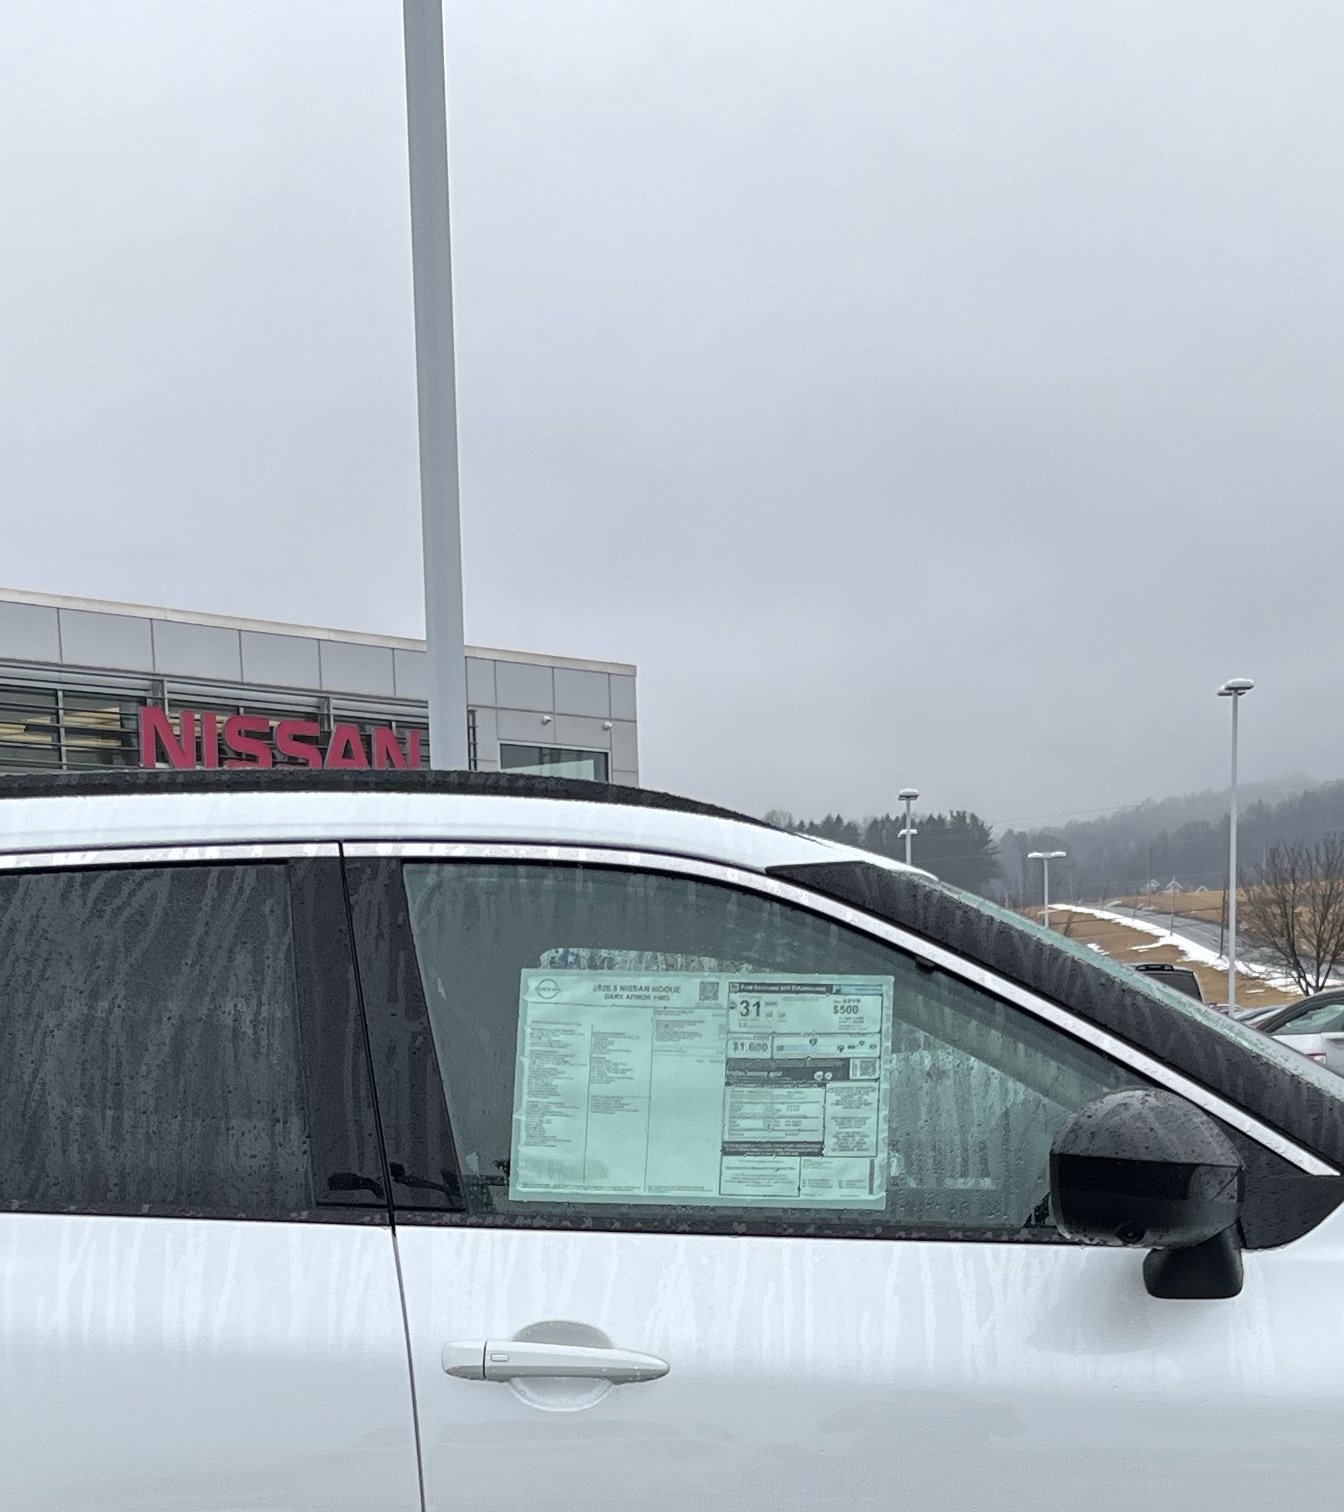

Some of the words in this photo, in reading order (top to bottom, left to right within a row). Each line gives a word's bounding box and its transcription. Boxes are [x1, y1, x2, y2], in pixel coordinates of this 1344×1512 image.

[139, 705, 422, 771] NISSAN
[739, 999, 761, 1017] 31
[832, 1004, 859, 1015] $500
